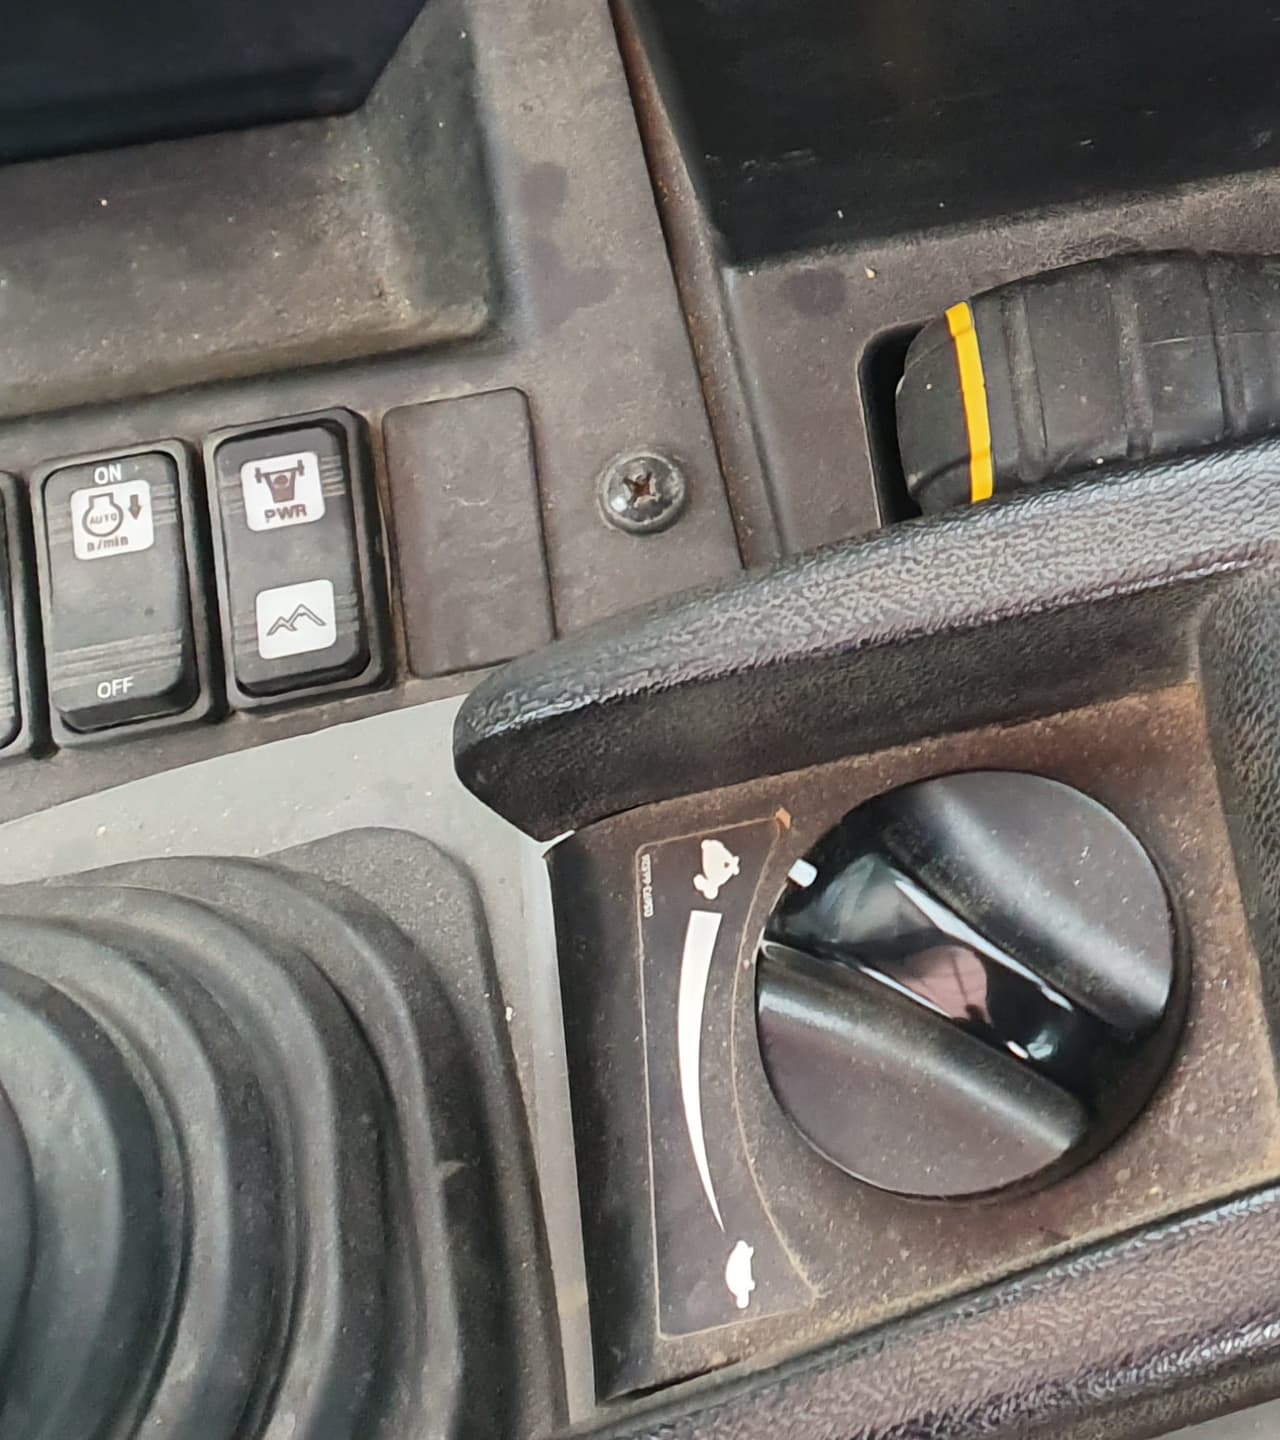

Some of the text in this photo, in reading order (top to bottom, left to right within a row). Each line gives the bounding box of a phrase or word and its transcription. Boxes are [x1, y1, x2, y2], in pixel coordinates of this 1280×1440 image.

[94, 464, 123, 484] ON
[89, 513, 118, 526] AUTO
[264, 504, 308, 523] PWR
[96, 676, 134, 699] OFF
